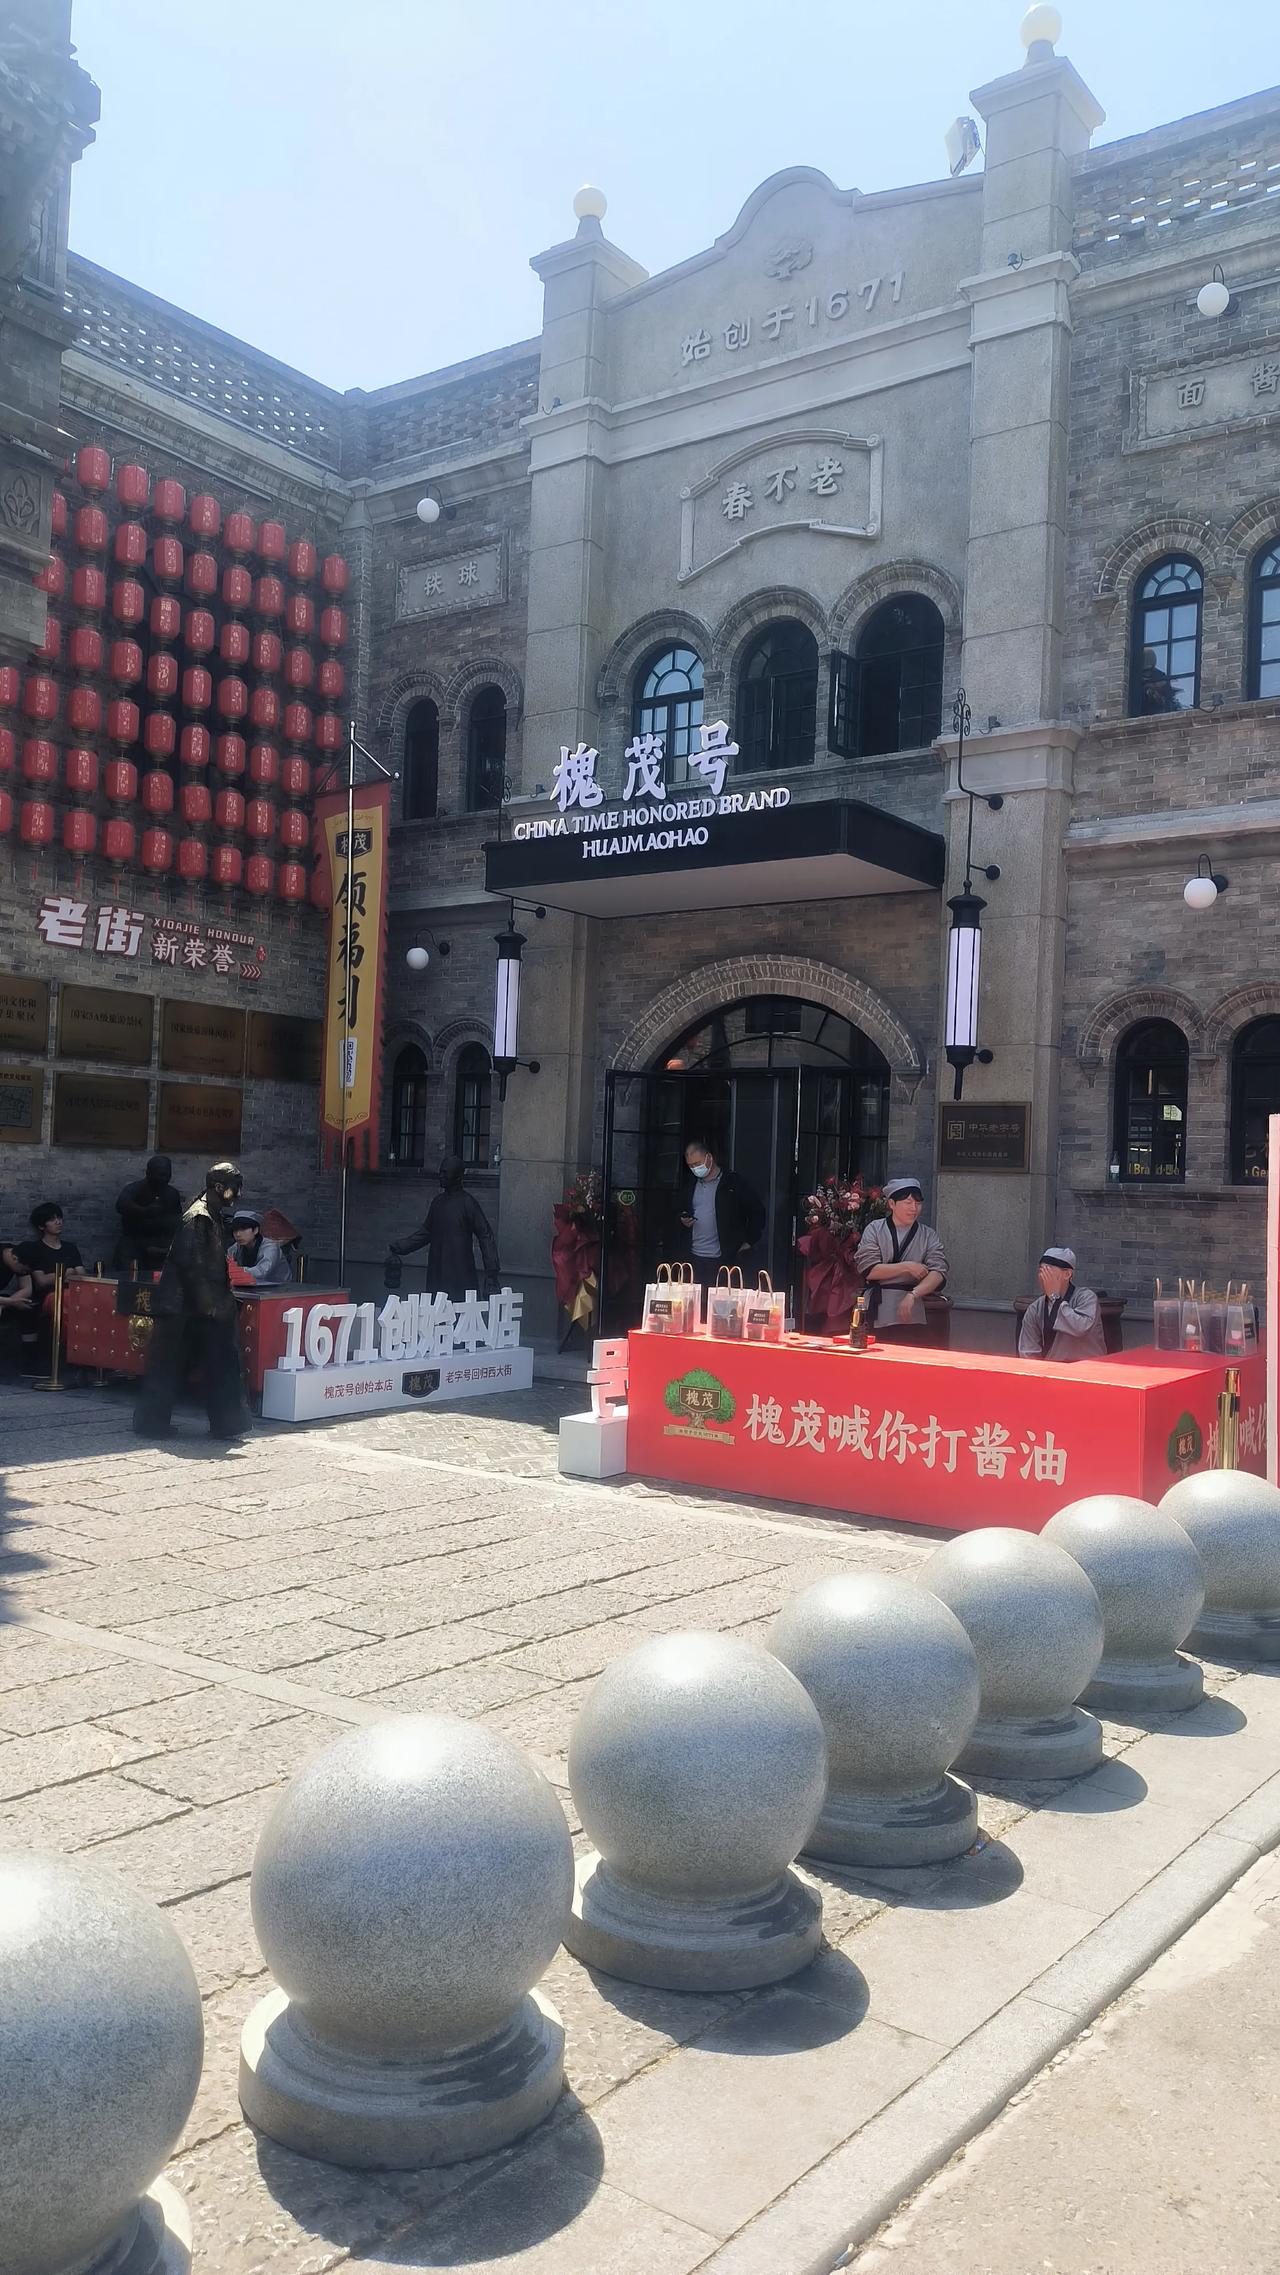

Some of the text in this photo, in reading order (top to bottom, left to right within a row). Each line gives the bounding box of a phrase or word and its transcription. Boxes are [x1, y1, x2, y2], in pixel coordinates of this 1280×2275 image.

[681, 271, 905, 367] 始创于1671
[1177, 360, 1280, 410] 面酱
[722, 456, 844, 520] 春不老
[424, 561, 478, 597] 铁球
[550, 720, 740, 813] 槐茂号
[514, 787, 791, 841] CHINA TIME HONORED BRAND
[582, 827, 709, 859] HUAIMAOHAO
[38, 897, 145, 956] 老街
[153, 933, 236, 972] 新荣誉
[154, 917, 255, 945] XIDAJIE HONOUR
[278, 1287, 524, 1369] 1671创始本店
[323, 1364, 512, 1399] 槐茂号创始本店 槐茂 老字号回归西大街
[686, 1390, 713, 1409] 槐茂
[743, 1393, 1067, 1486] 槐茂喊你打酱油
